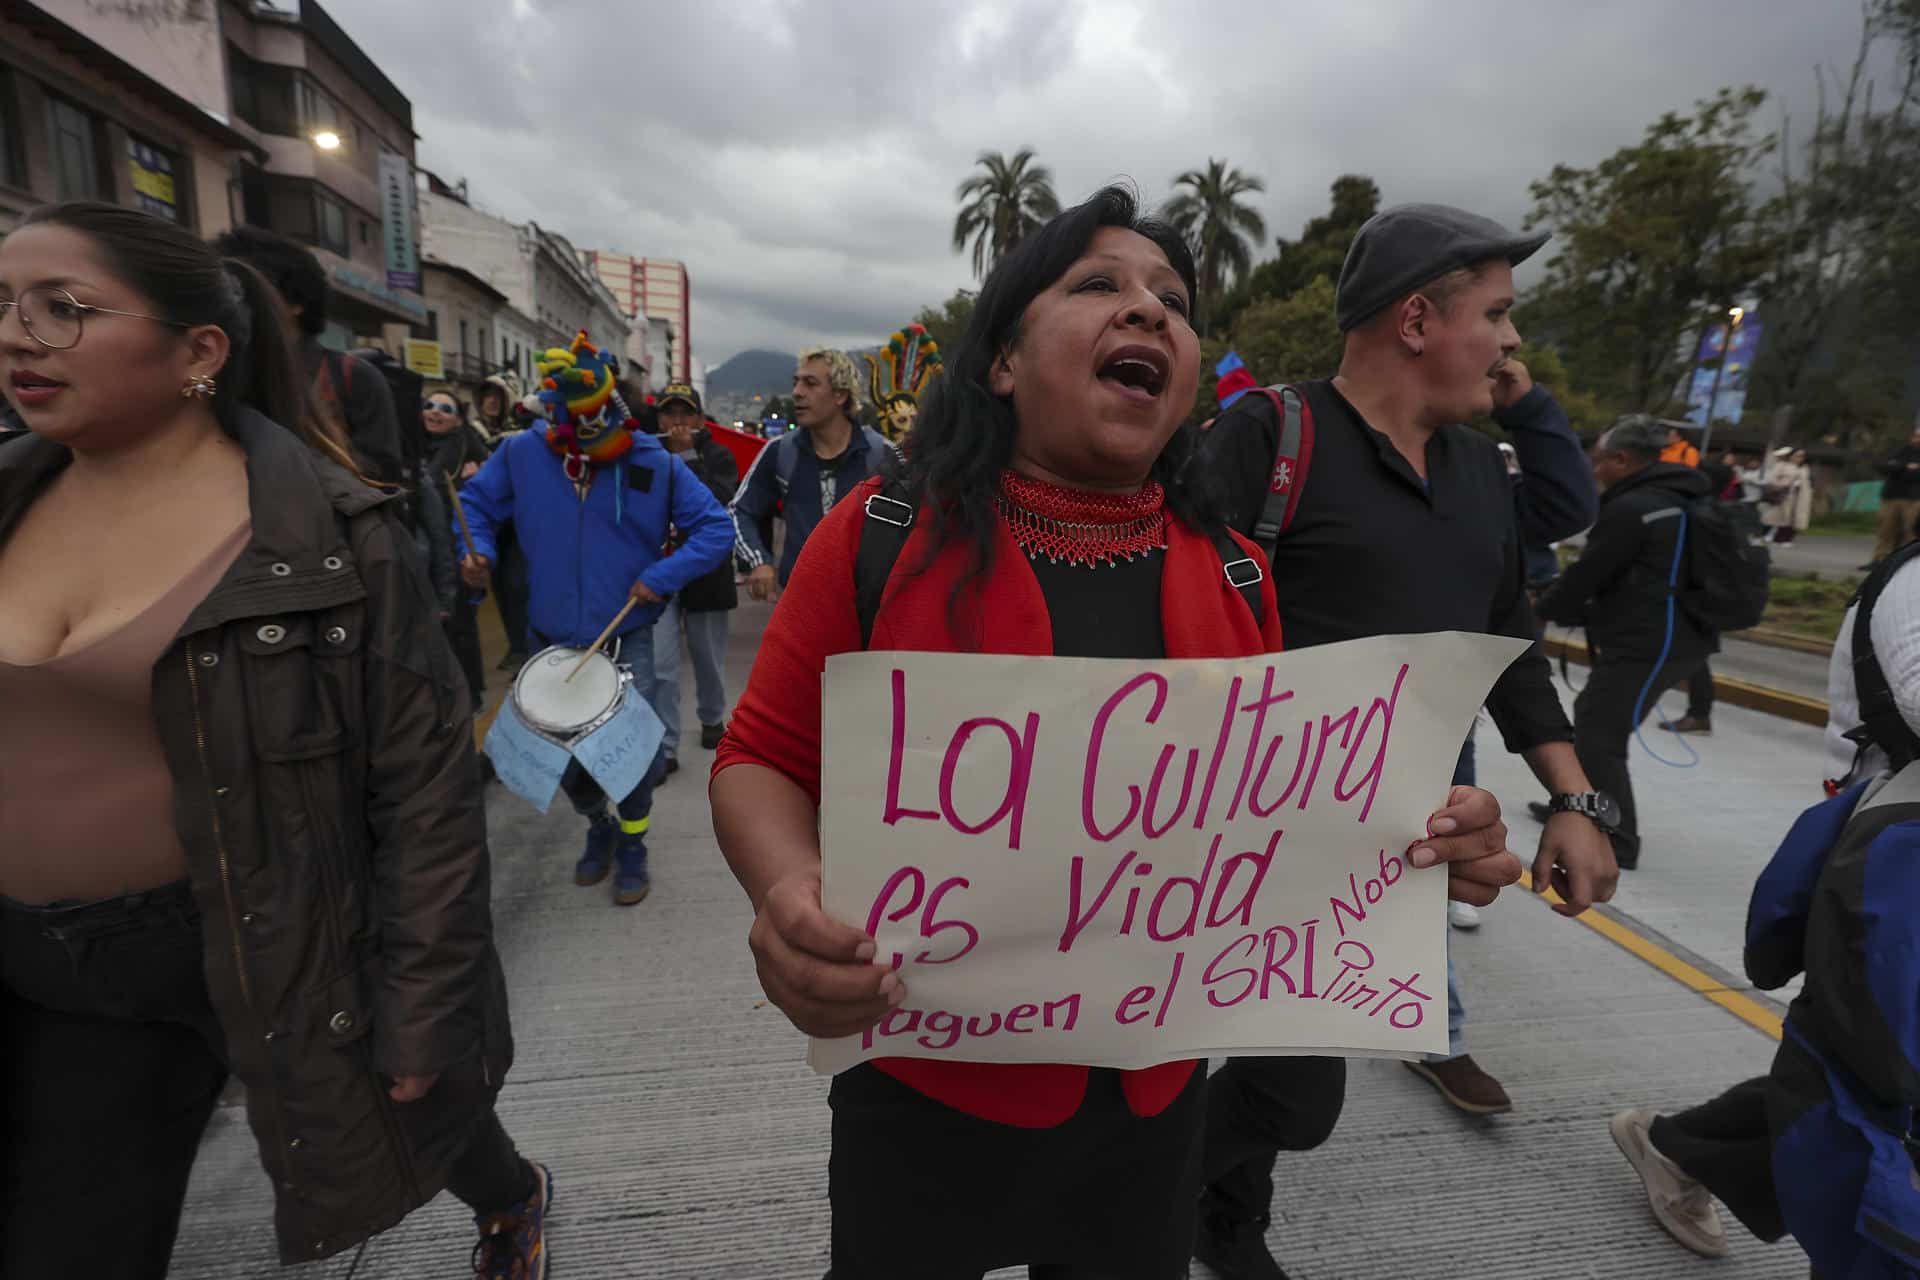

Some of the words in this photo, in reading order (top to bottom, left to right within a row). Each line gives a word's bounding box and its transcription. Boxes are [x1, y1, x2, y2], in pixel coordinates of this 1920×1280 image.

[882, 669, 1041, 850] La
[1081, 663, 1409, 842] Cultura
[863, 866, 979, 971] es
[1058, 830, 1284, 953] Vida
[1115, 951, 1185, 1028] el
[1201, 919, 1320, 1008] SRI
[1320, 940, 1432, 1029] Pinto
